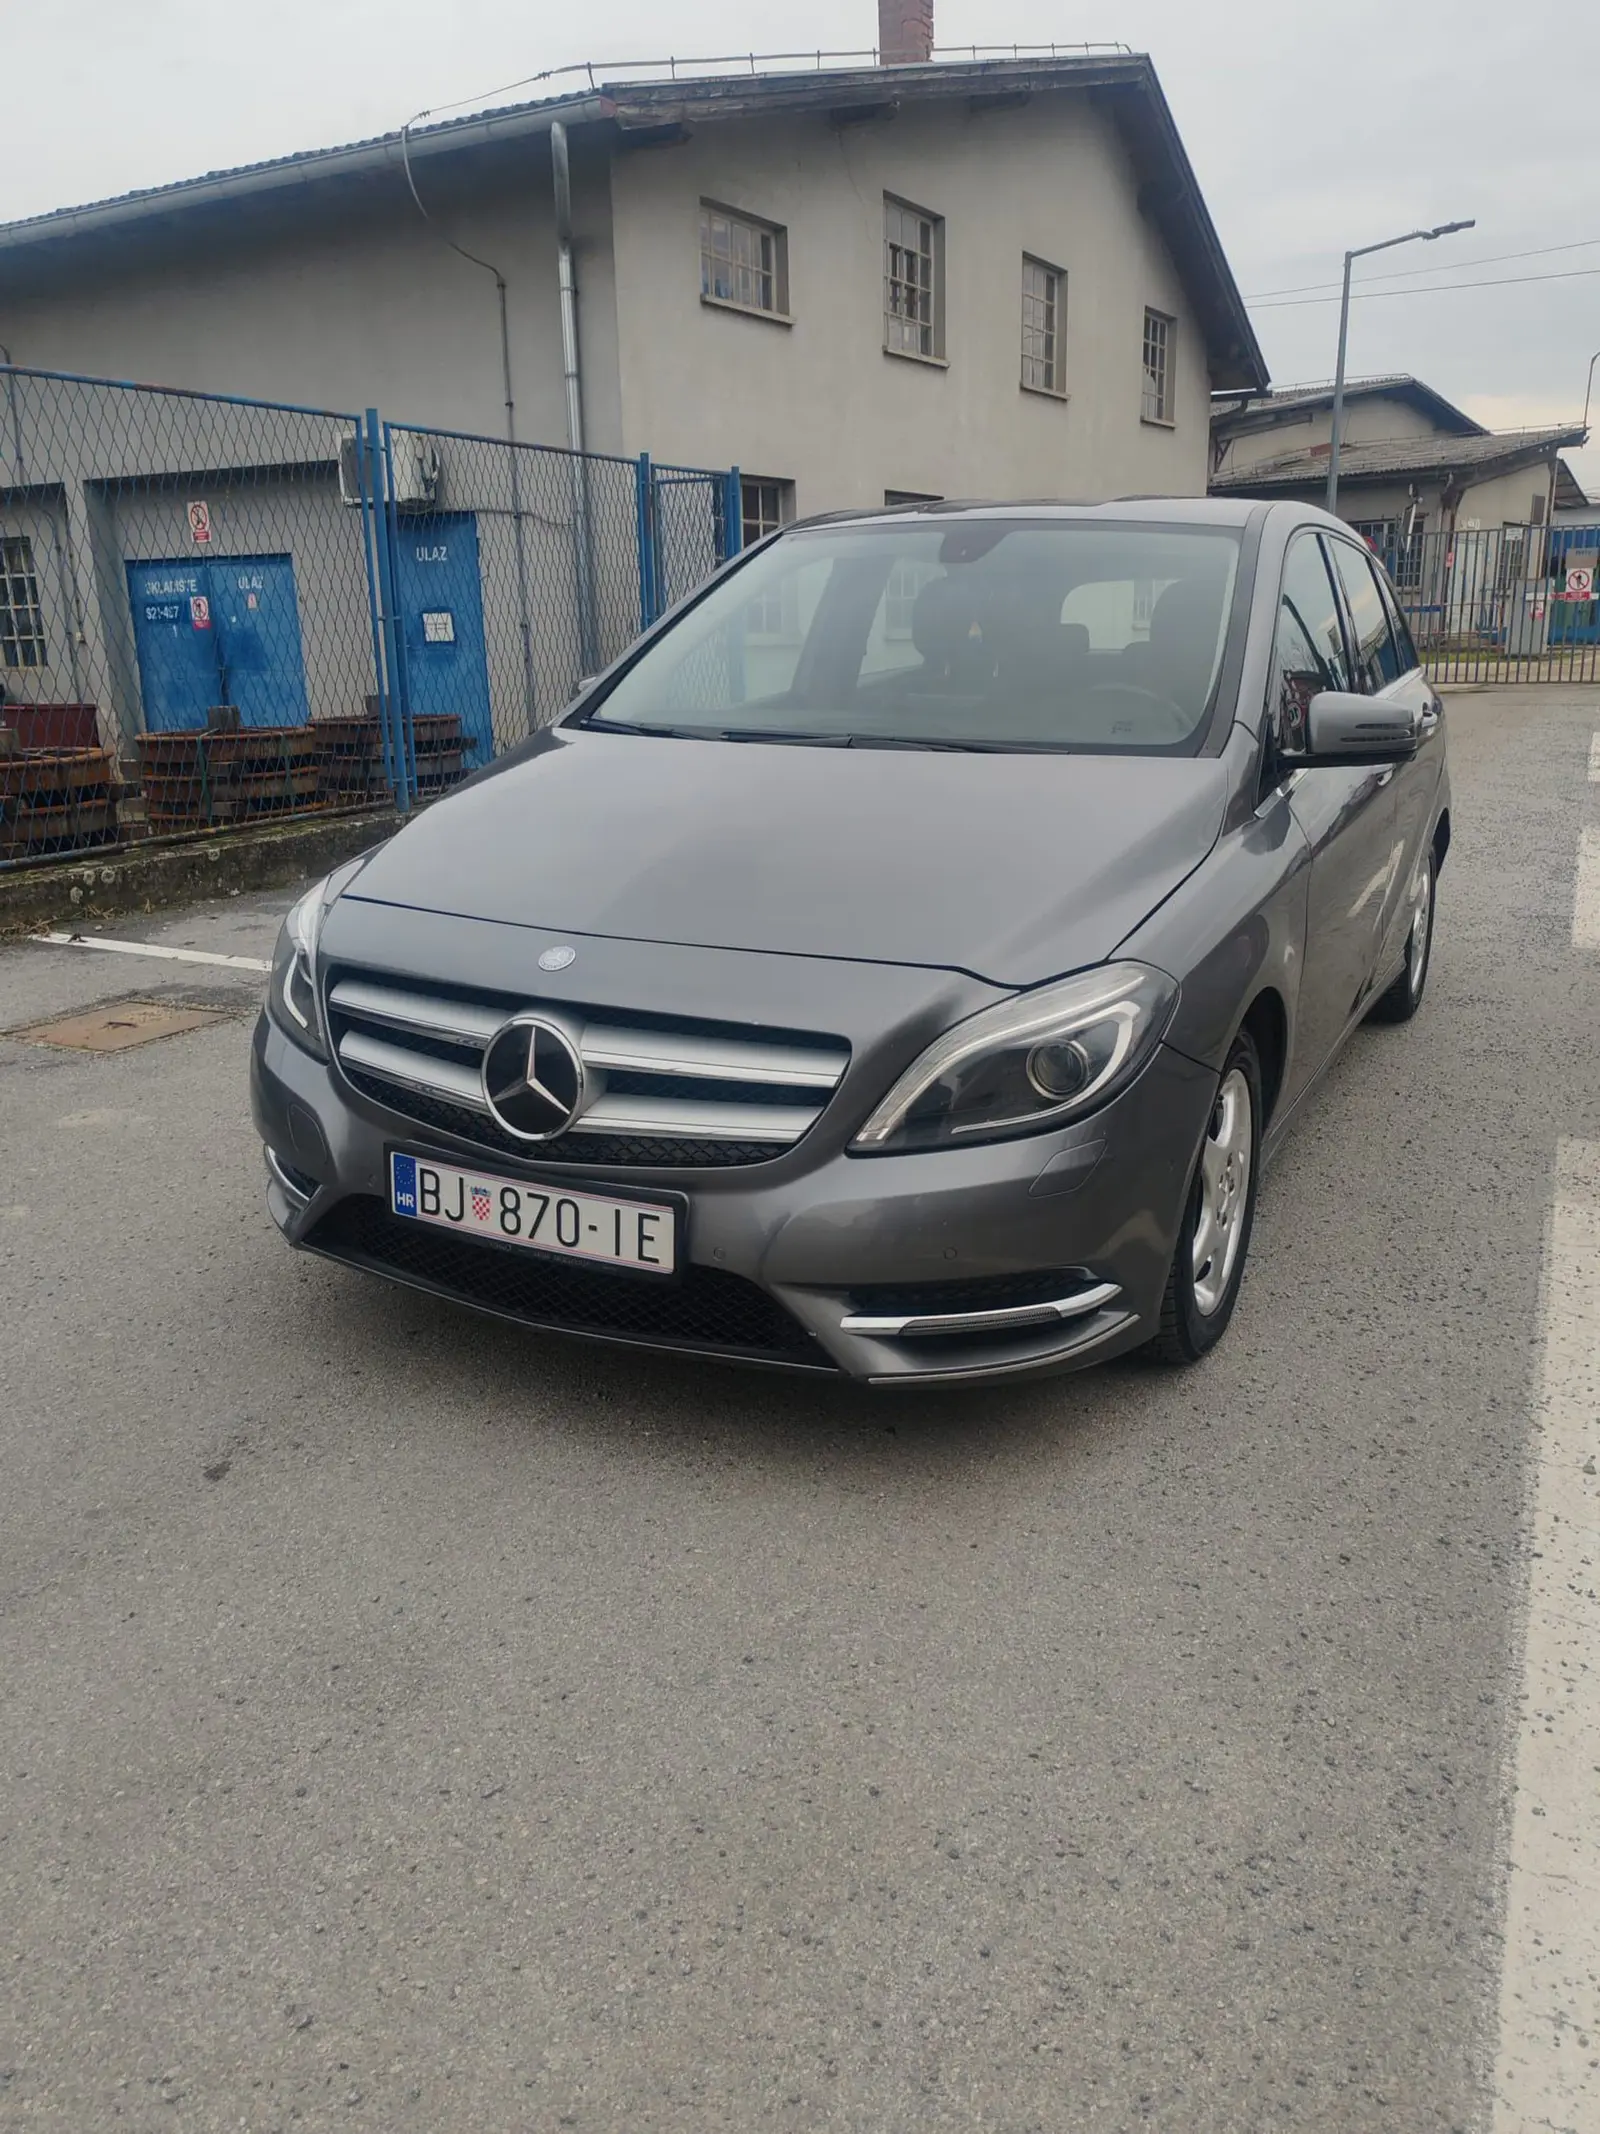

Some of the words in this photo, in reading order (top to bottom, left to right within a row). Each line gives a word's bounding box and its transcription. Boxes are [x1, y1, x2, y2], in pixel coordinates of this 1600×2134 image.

[416, 546, 448, 562] ULAZ
[238, 575, 264, 590] ULAZ
[396, 1191, 415, 1208] HR
[419, 1167, 465, 1222] BJ
[499, 1186, 660, 1264] 870-IE
